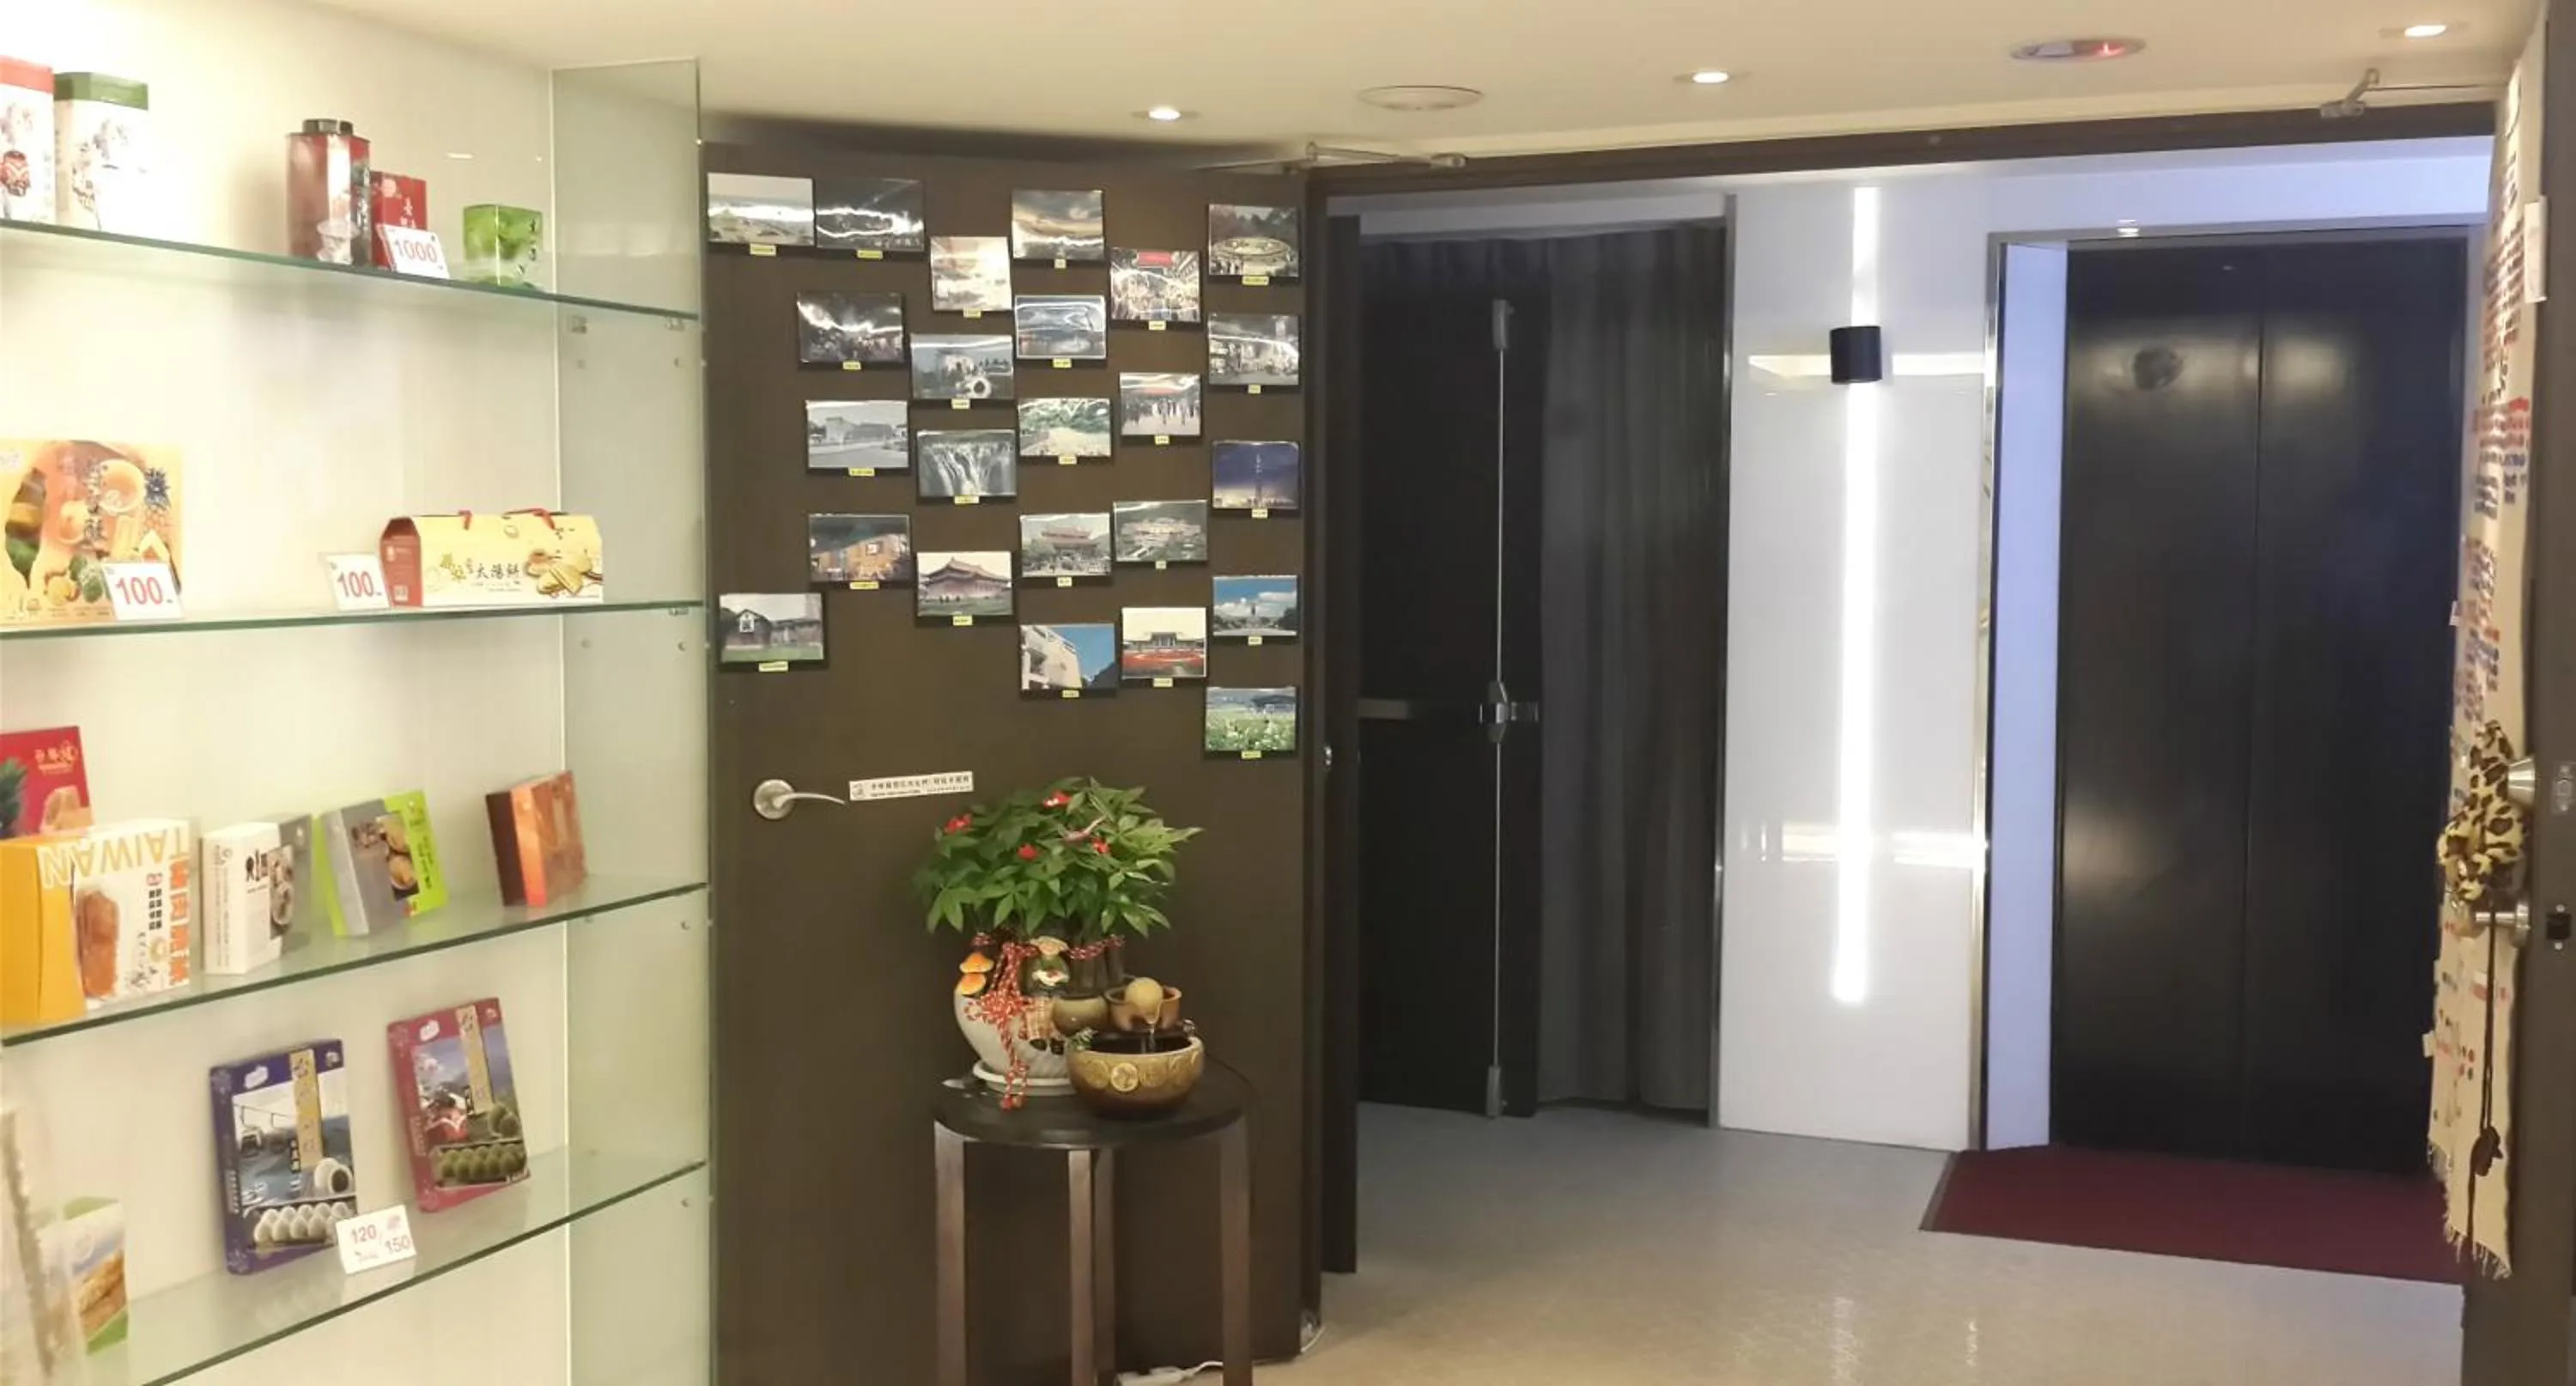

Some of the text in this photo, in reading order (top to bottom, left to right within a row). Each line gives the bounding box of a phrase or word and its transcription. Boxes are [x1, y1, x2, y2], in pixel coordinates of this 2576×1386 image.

[394, 240, 437, 263] 1000
[116, 576, 163, 605] 100
[37, 826, 190, 889] TAIWAN
